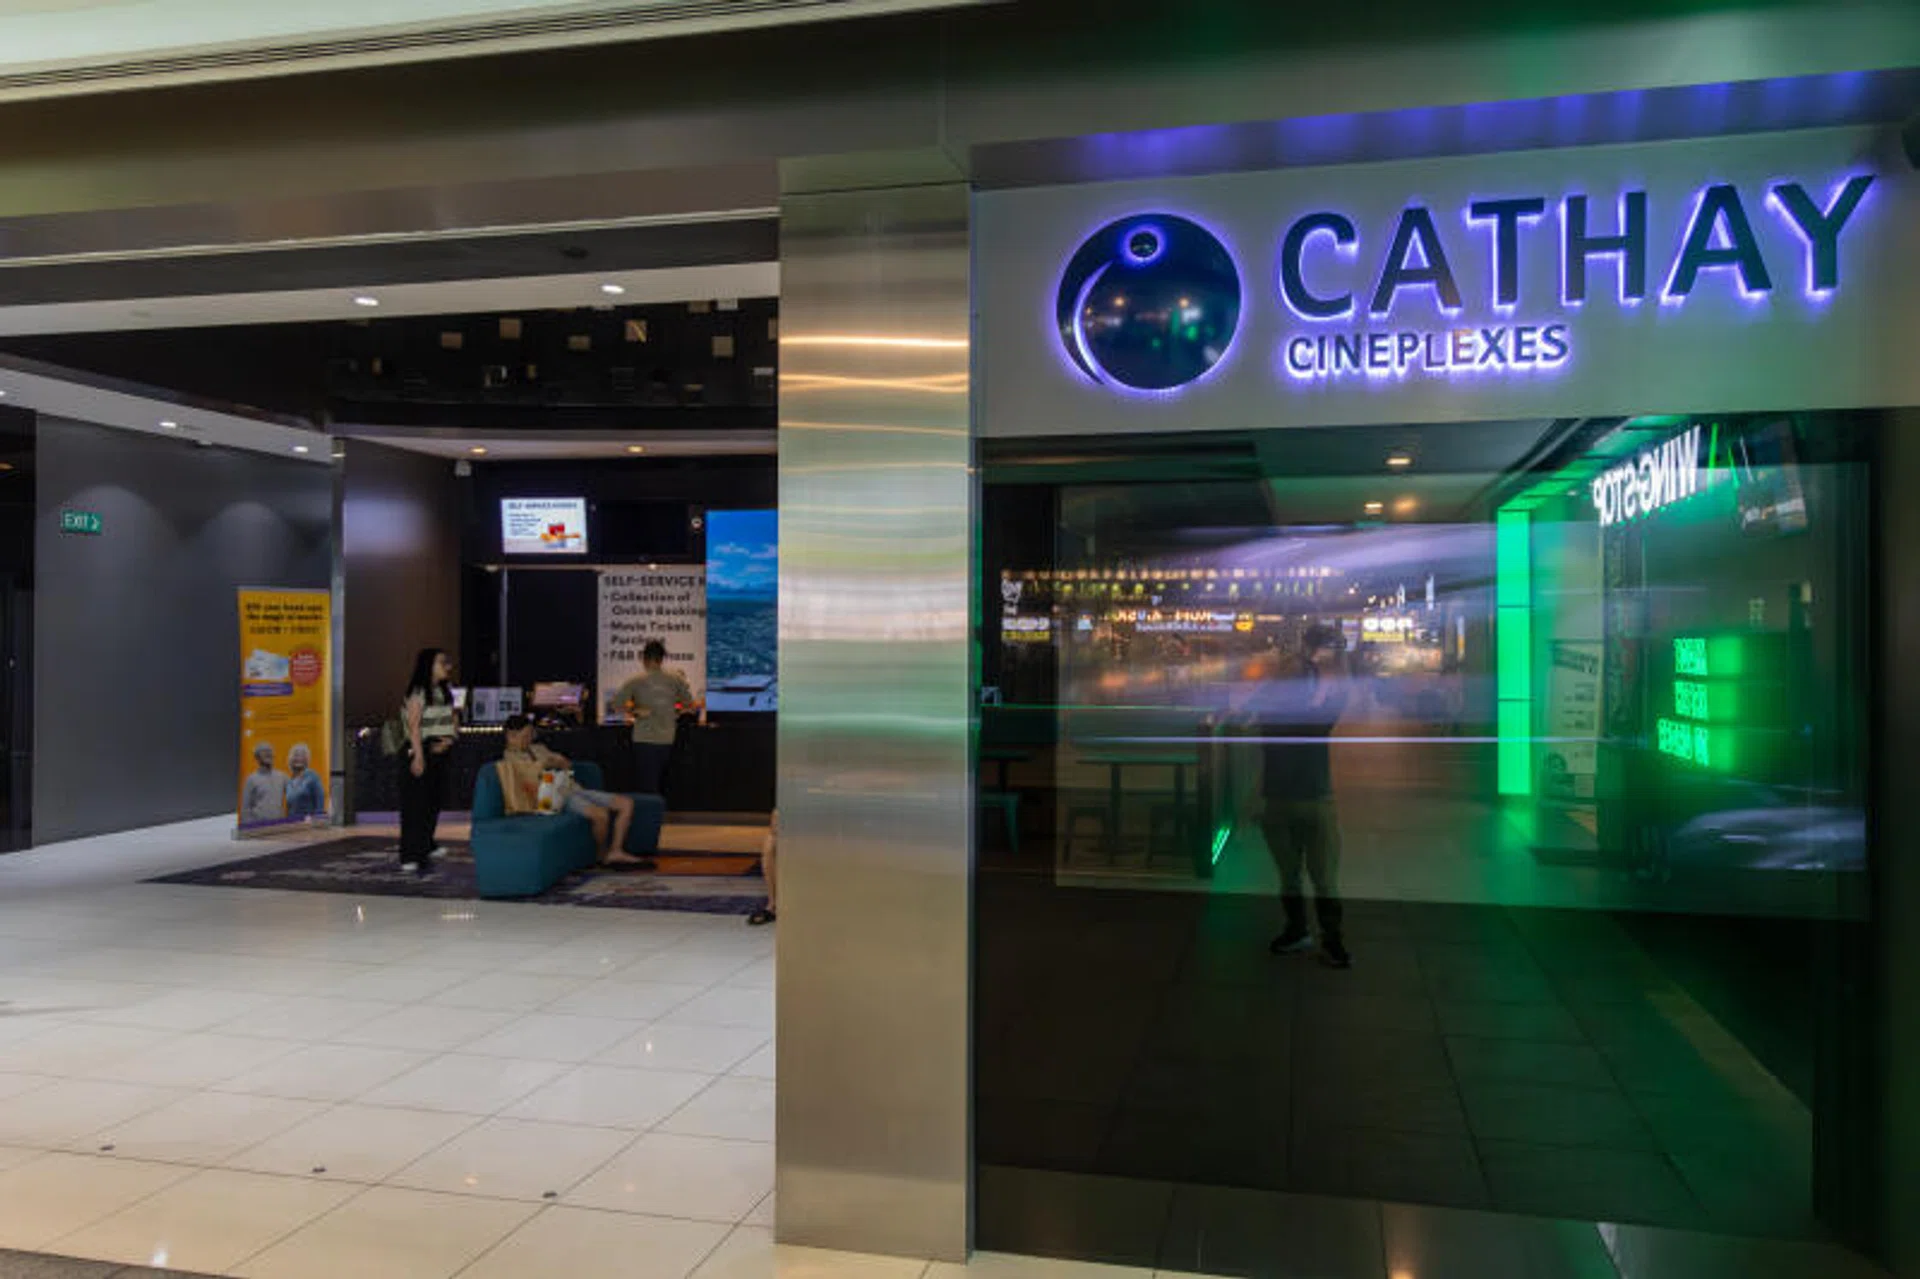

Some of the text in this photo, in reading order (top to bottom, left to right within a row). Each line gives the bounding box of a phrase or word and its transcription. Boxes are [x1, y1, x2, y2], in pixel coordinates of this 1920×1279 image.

[1280, 174, 1875, 320] CATHAY
[1287, 324, 1569, 377] CINEPLEXES
[64, 512, 88, 529] EXIT
[604, 576, 694, 587] SELF-SERVICE
[610, 592, 691, 601] Collection of
[612, 604, 653, 615] Online
[610, 621, 692, 631] Movie Tickets
